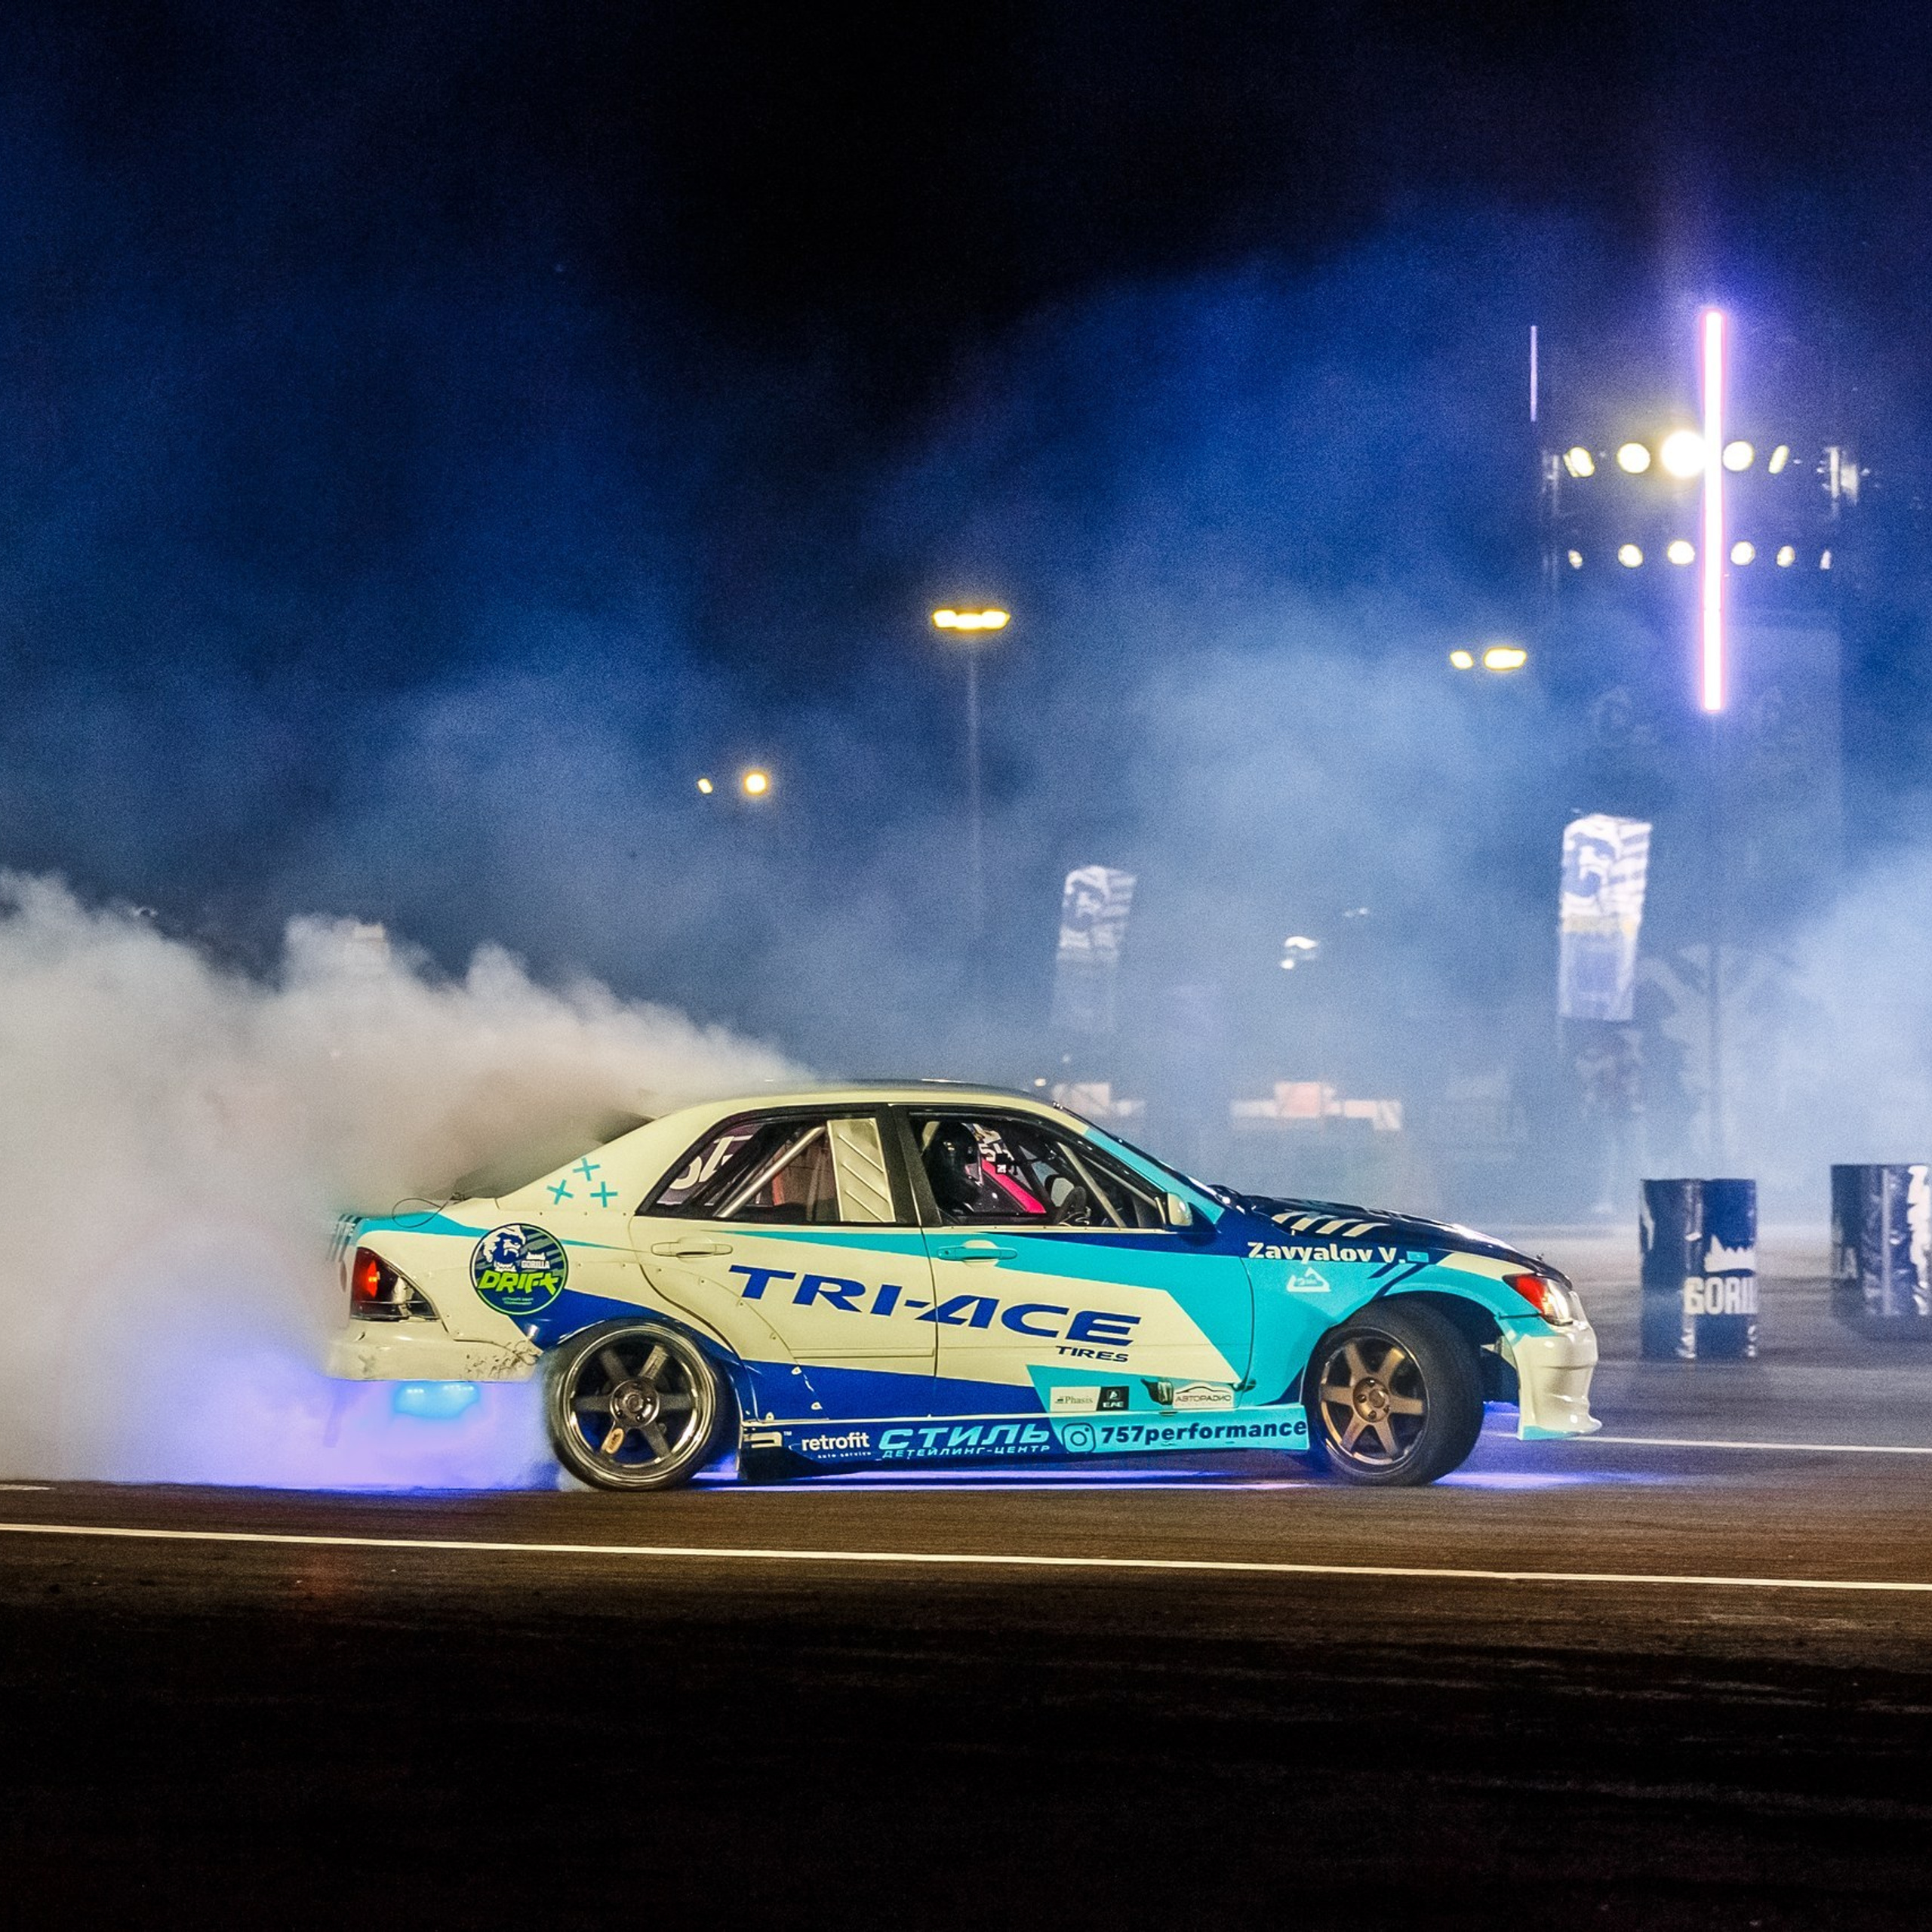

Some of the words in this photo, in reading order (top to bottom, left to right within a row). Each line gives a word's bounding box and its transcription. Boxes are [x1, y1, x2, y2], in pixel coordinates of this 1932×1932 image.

[1247, 1241, 1374, 1264] Zavyalov
[1378, 1247, 1406, 1263] V.
[478, 1269, 559, 1295] DRIFT
[728, 1264, 1141, 1346] TRI-ACE
[1057, 1346, 1129, 1363] TIRES
[1175, 1394, 1232, 1402] АВТОРАДИО
[801, 1432, 870, 1451] retrofit
[878, 1423, 1050, 1450] СТИЛЬ
[1101, 1420, 1307, 1444] 757performance
[881, 1444, 1051, 1458] ДЕТЕЙЛИНГ-ЦЕНТР
